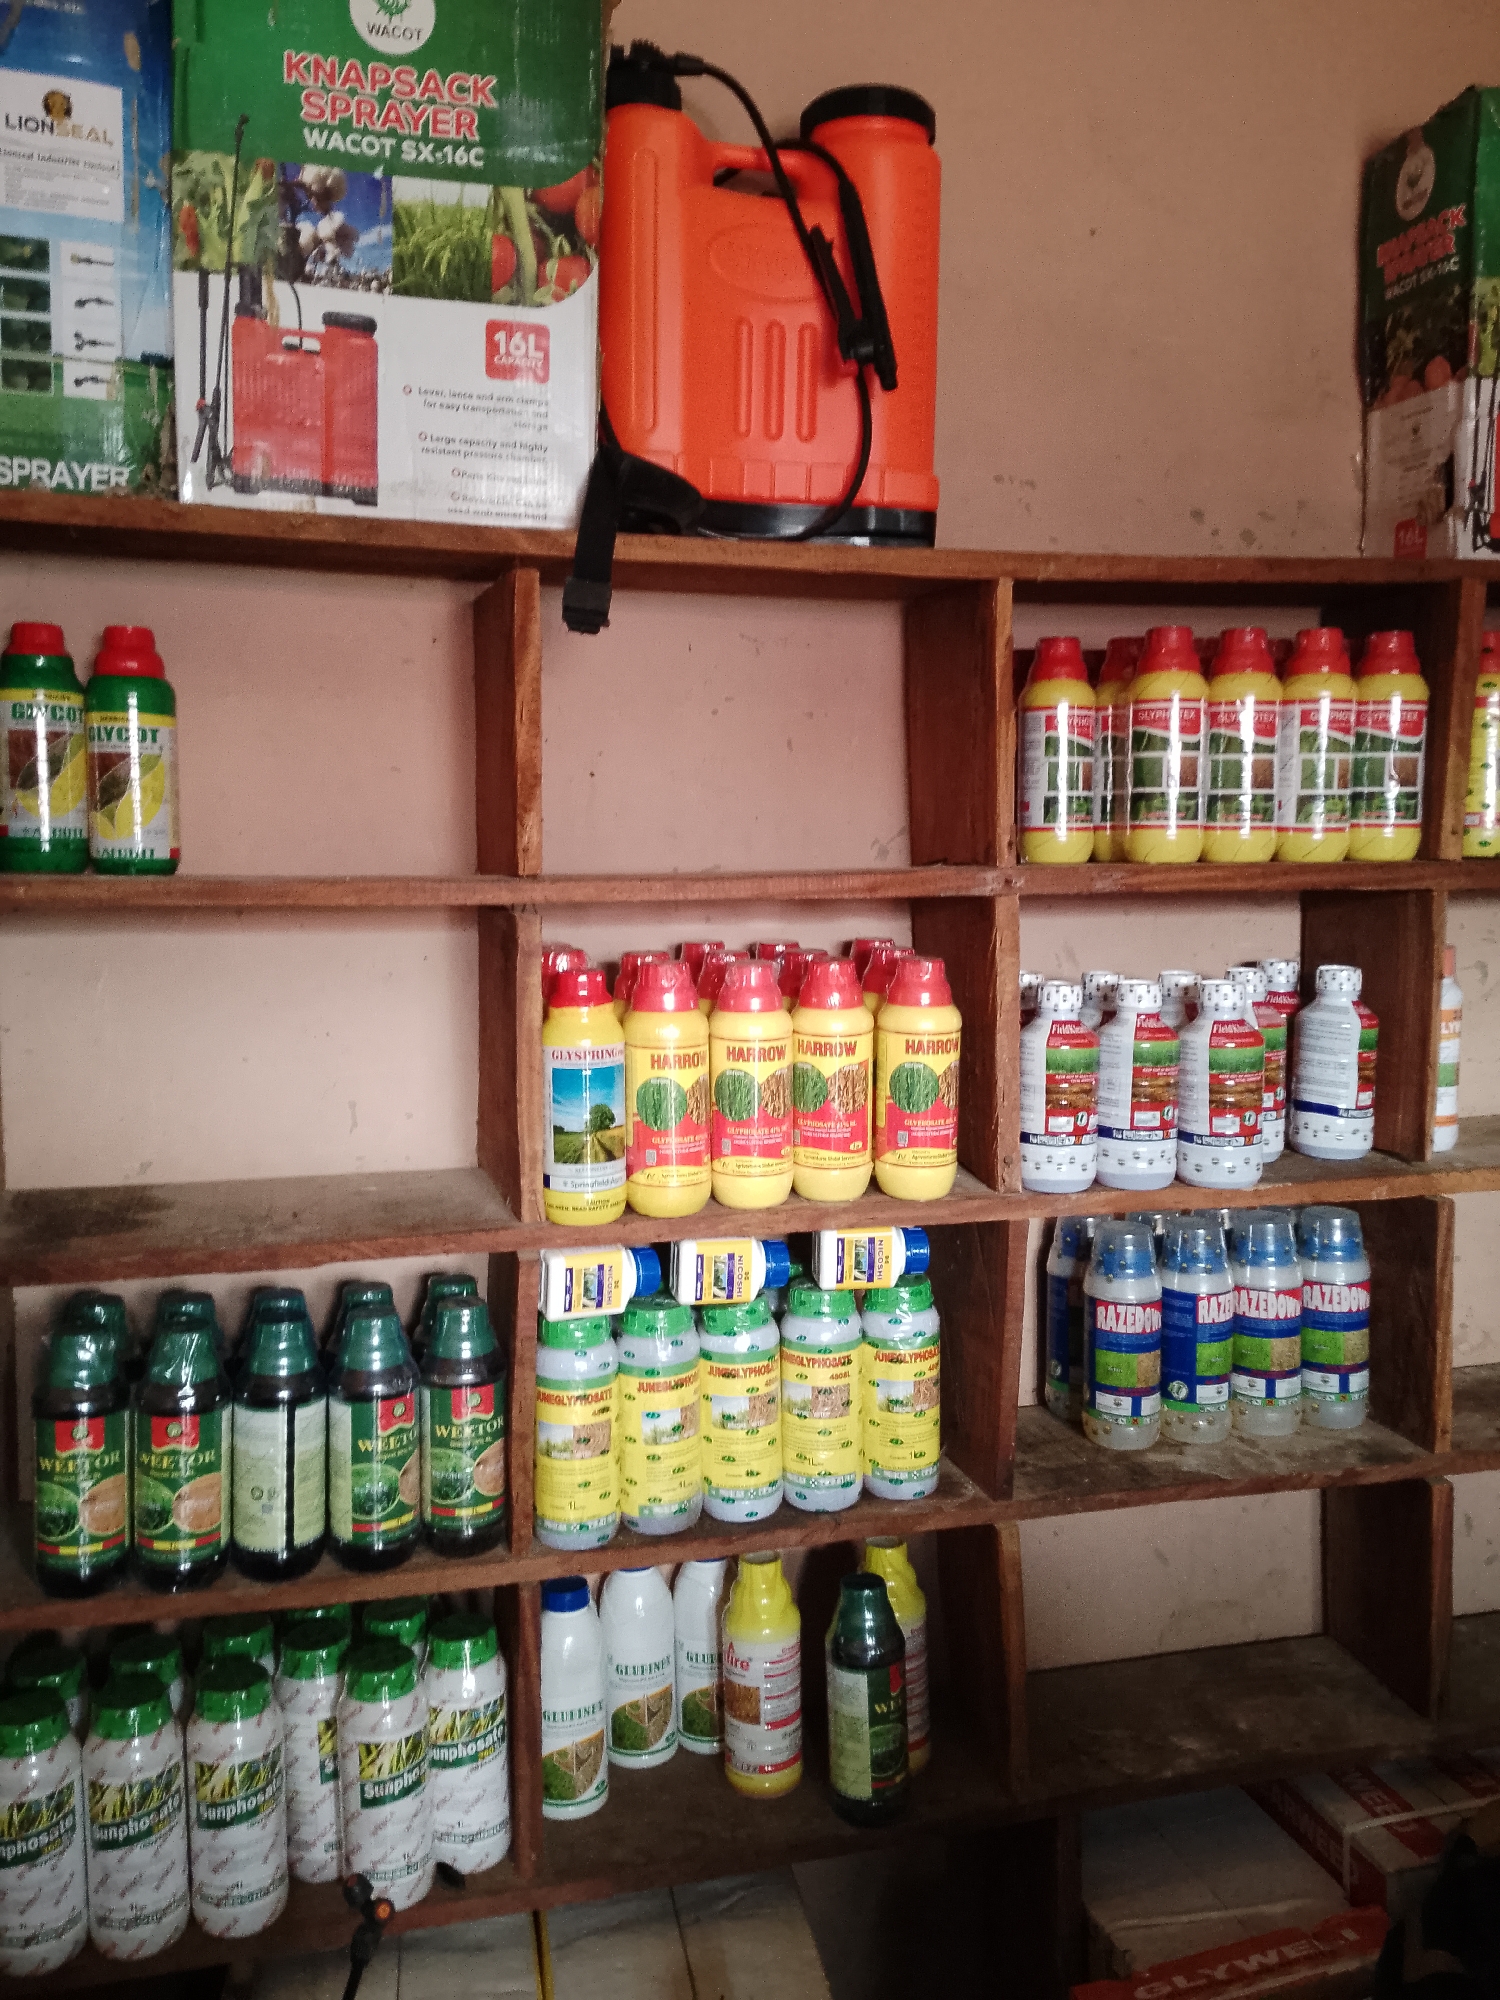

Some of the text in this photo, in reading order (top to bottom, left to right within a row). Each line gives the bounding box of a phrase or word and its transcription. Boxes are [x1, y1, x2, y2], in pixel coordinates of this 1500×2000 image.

[366, 22, 422, 41] WACOT
[283, 49, 499, 108] KNAPSACK
[300, 88, 480, 141] SPRAYER
[5, 112, 114, 148] LIONSEAL
[302, 127, 397, 159] WACOT
[494, 331, 545, 359] 16L
[421, 446, 461, 457] resistant
[463, 450, 503, 460] pressure
[430, 434, 548, 453] Large capacity and highly
[0, 455, 130, 492] SPRAYER
[551, 1049, 618, 1061] GLYSPRING
[726, 1046, 787, 1063] HARROW
[798, 1040, 858, 1057] HARROW
[904, 1038, 960, 1056] HARROW
[650, 1050, 708, 1070] HARROW
[571, 1178, 609, 1189] Springfield
